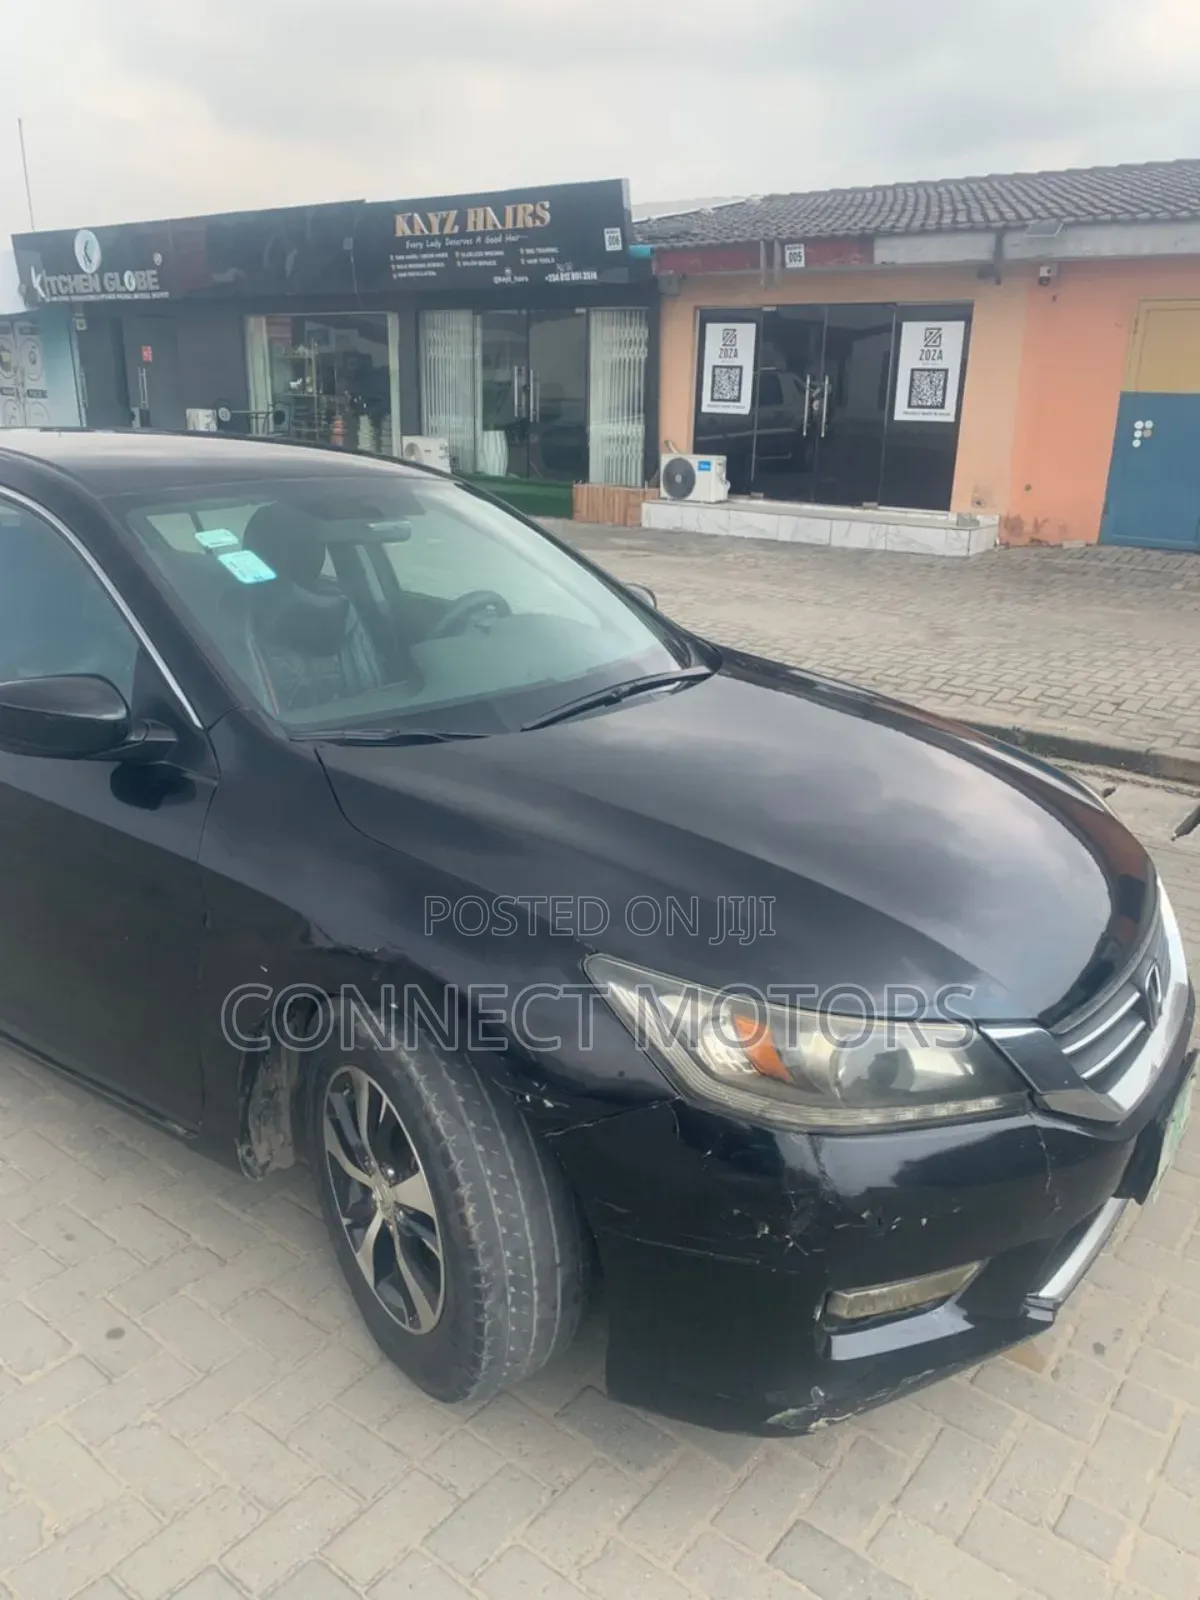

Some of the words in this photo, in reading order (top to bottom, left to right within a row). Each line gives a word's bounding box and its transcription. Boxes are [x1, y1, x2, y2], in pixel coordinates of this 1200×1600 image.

[394, 209, 460, 237] KAYZ
[465, 200, 551, 232] HAIRS
[425, 237, 442, 249] Lady
[475, 235, 482, 244] A
[485, 233, 502, 244] Good
[31, 265, 100, 298] KITCHEN
[103, 269, 160, 292] GLOBE
[718, 347, 738, 359] ZOZA
[919, 349, 943, 361] ZOZA
